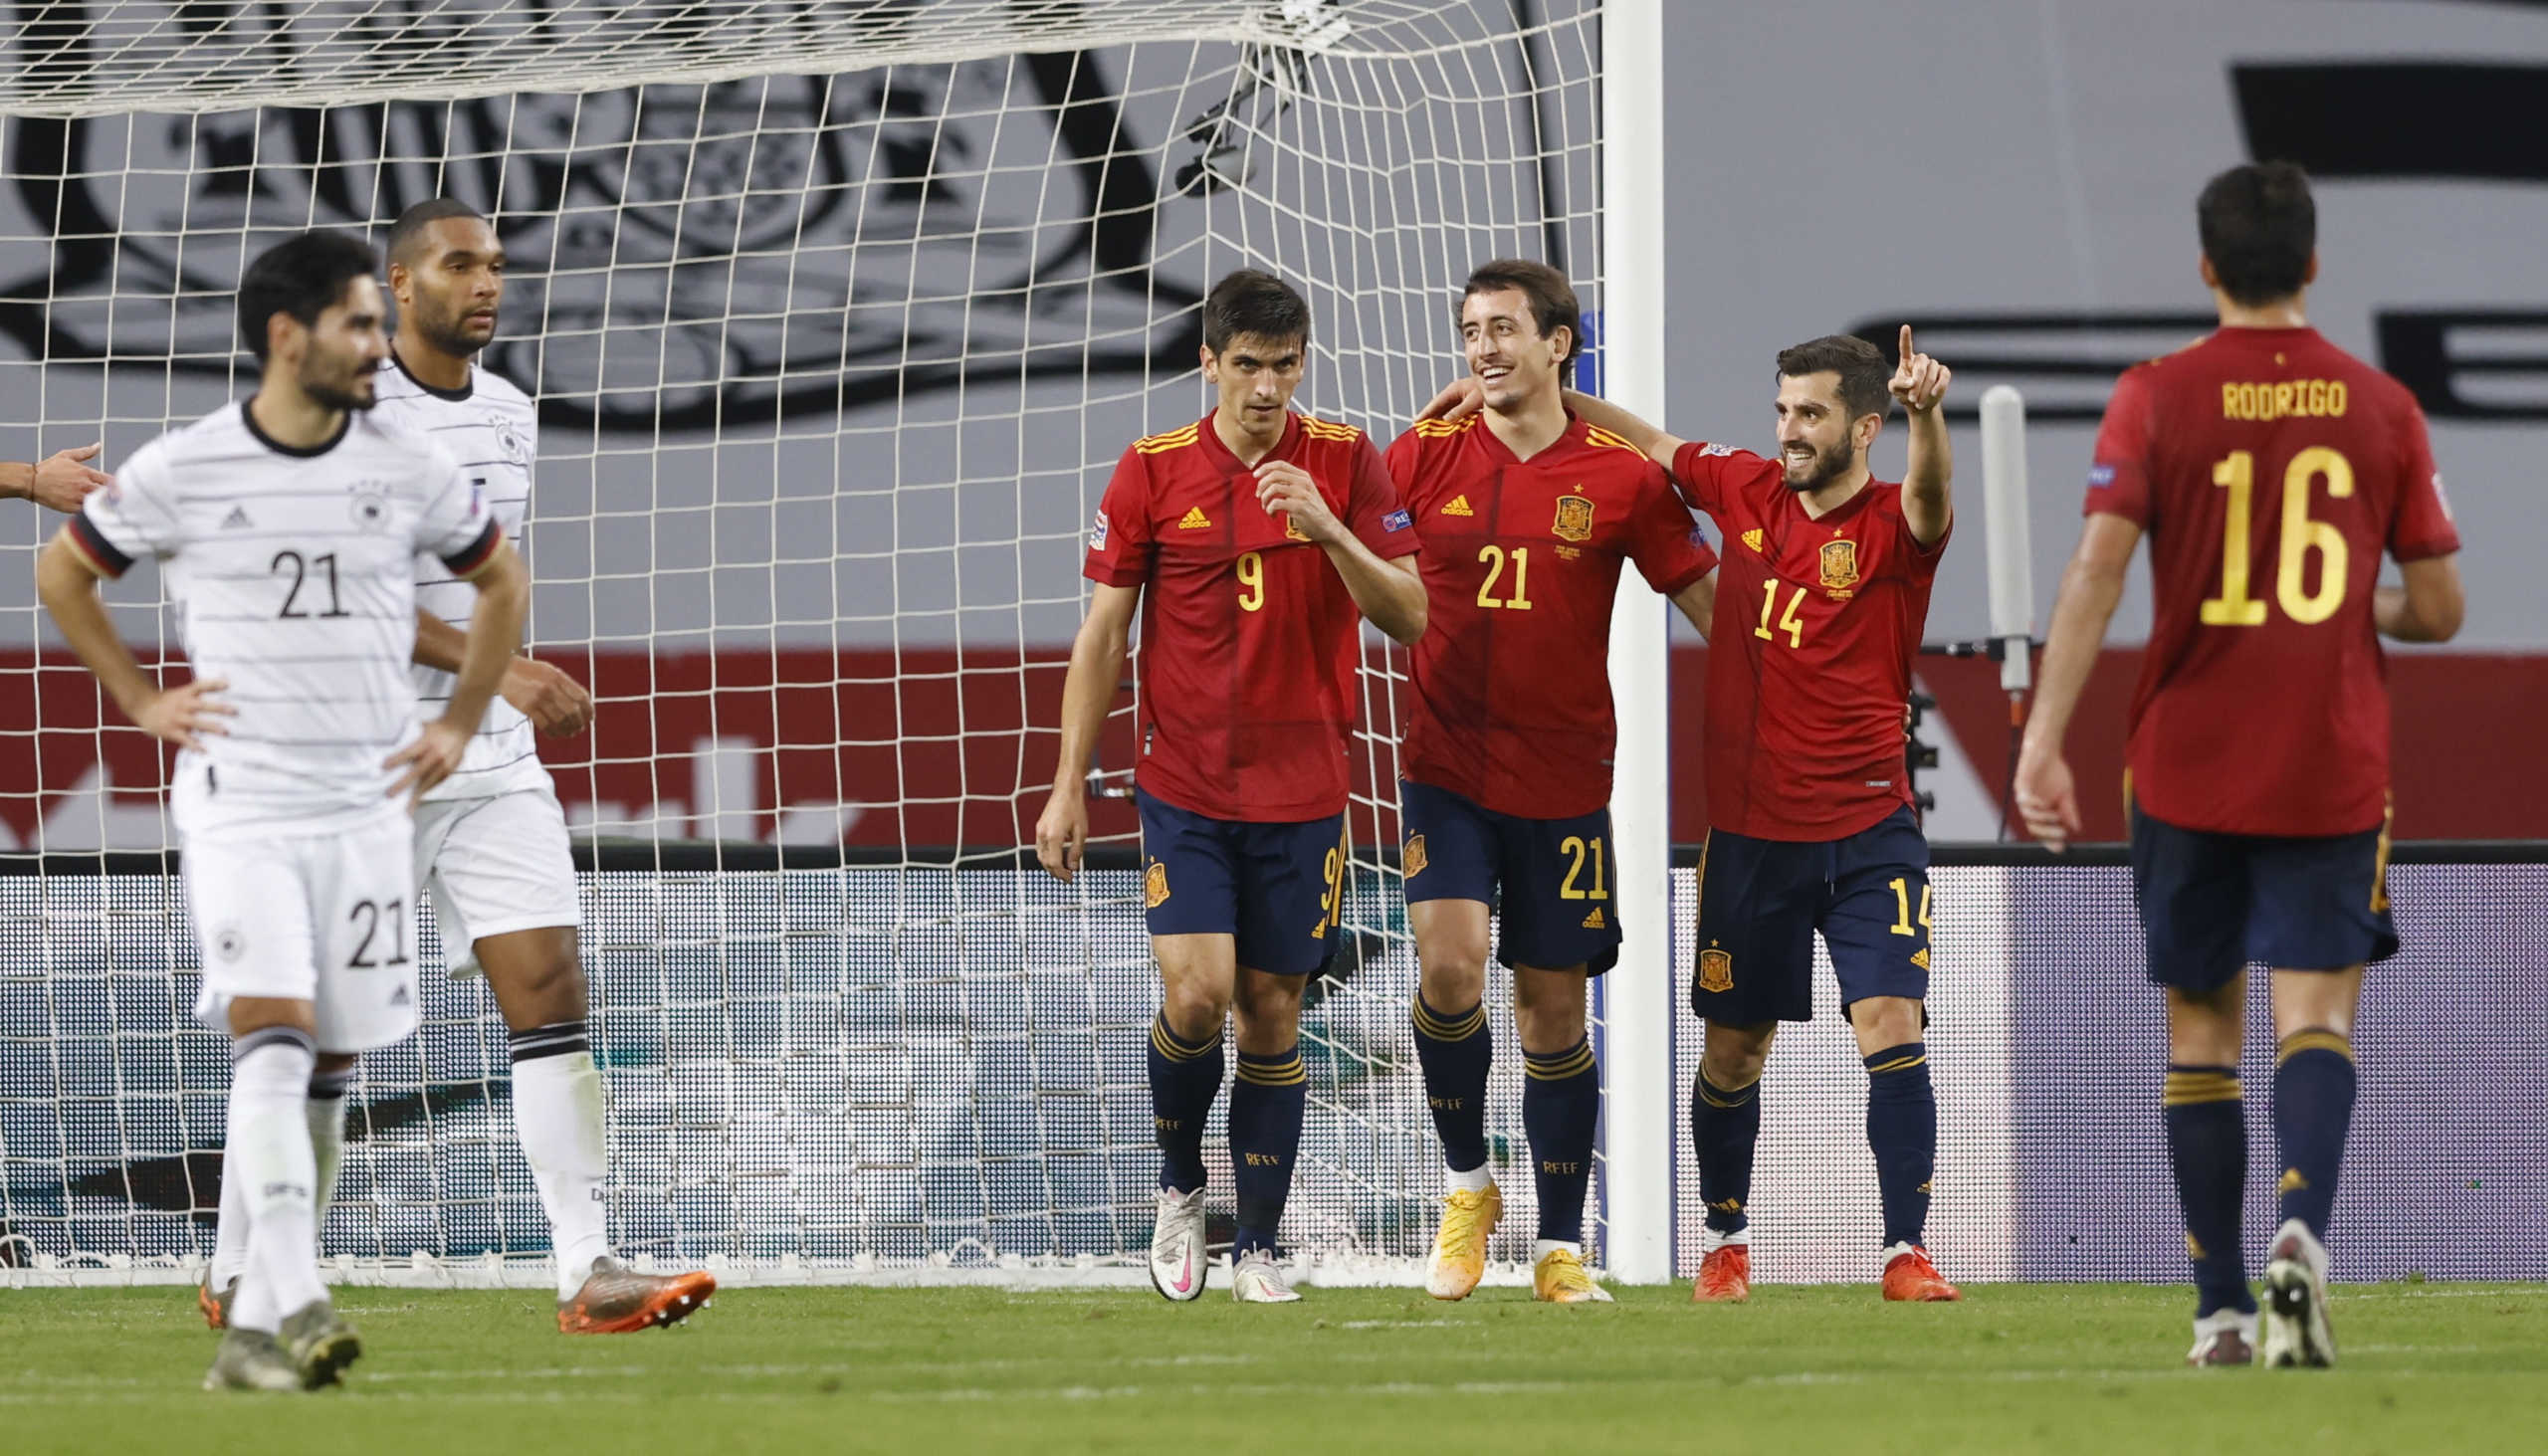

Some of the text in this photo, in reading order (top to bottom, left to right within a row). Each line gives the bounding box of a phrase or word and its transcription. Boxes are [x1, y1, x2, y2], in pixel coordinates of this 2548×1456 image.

[2222, 379, 2348, 422] RODRIGO
[1178, 520, 1211, 529] adidas
[1441, 507, 1473, 517] adidas
[2201, 446, 2355, 625] 16
[271, 550, 350, 618] 21
[1236, 551, 1264, 612] 9
[1477, 545, 1532, 610] 21
[1754, 578, 1807, 649] 14
[1321, 847, 1337, 911] 9
[1561, 836, 1607, 900] 21
[347, 900, 409, 969] 21
[1889, 878, 1932, 944] 14
[1430, 1096, 1464, 1111] RFEF
[1244, 1152, 1280, 1166] RFEF
[1543, 1160, 1579, 1174] RFEF
